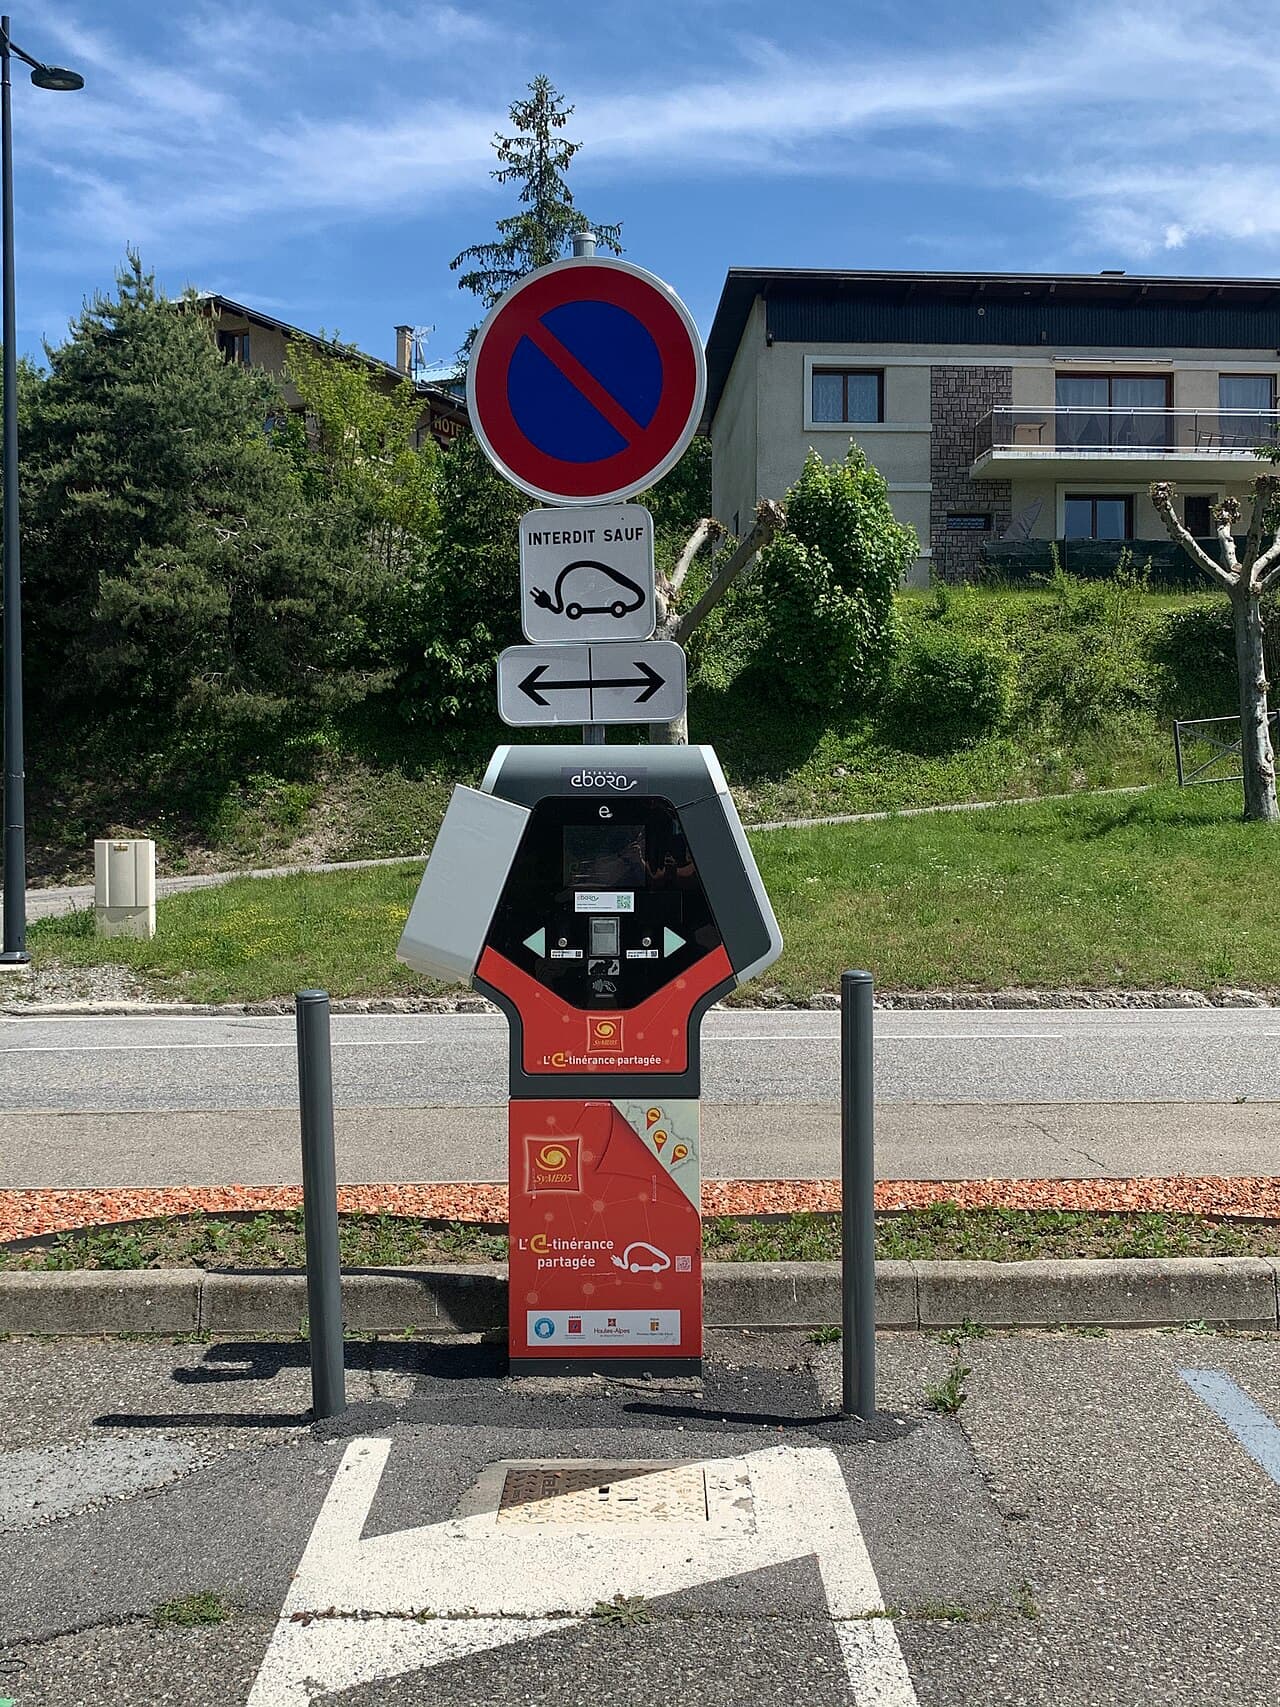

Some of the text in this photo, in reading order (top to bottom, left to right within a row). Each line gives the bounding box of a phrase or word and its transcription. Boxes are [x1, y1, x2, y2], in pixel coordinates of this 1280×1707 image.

[434, 415, 466, 438] HOTE
[528, 527, 644, 546] INTERDIT SAUF
[617, 1054, 661, 1067] partagée
[537, 1254, 596, 1270] partagée
